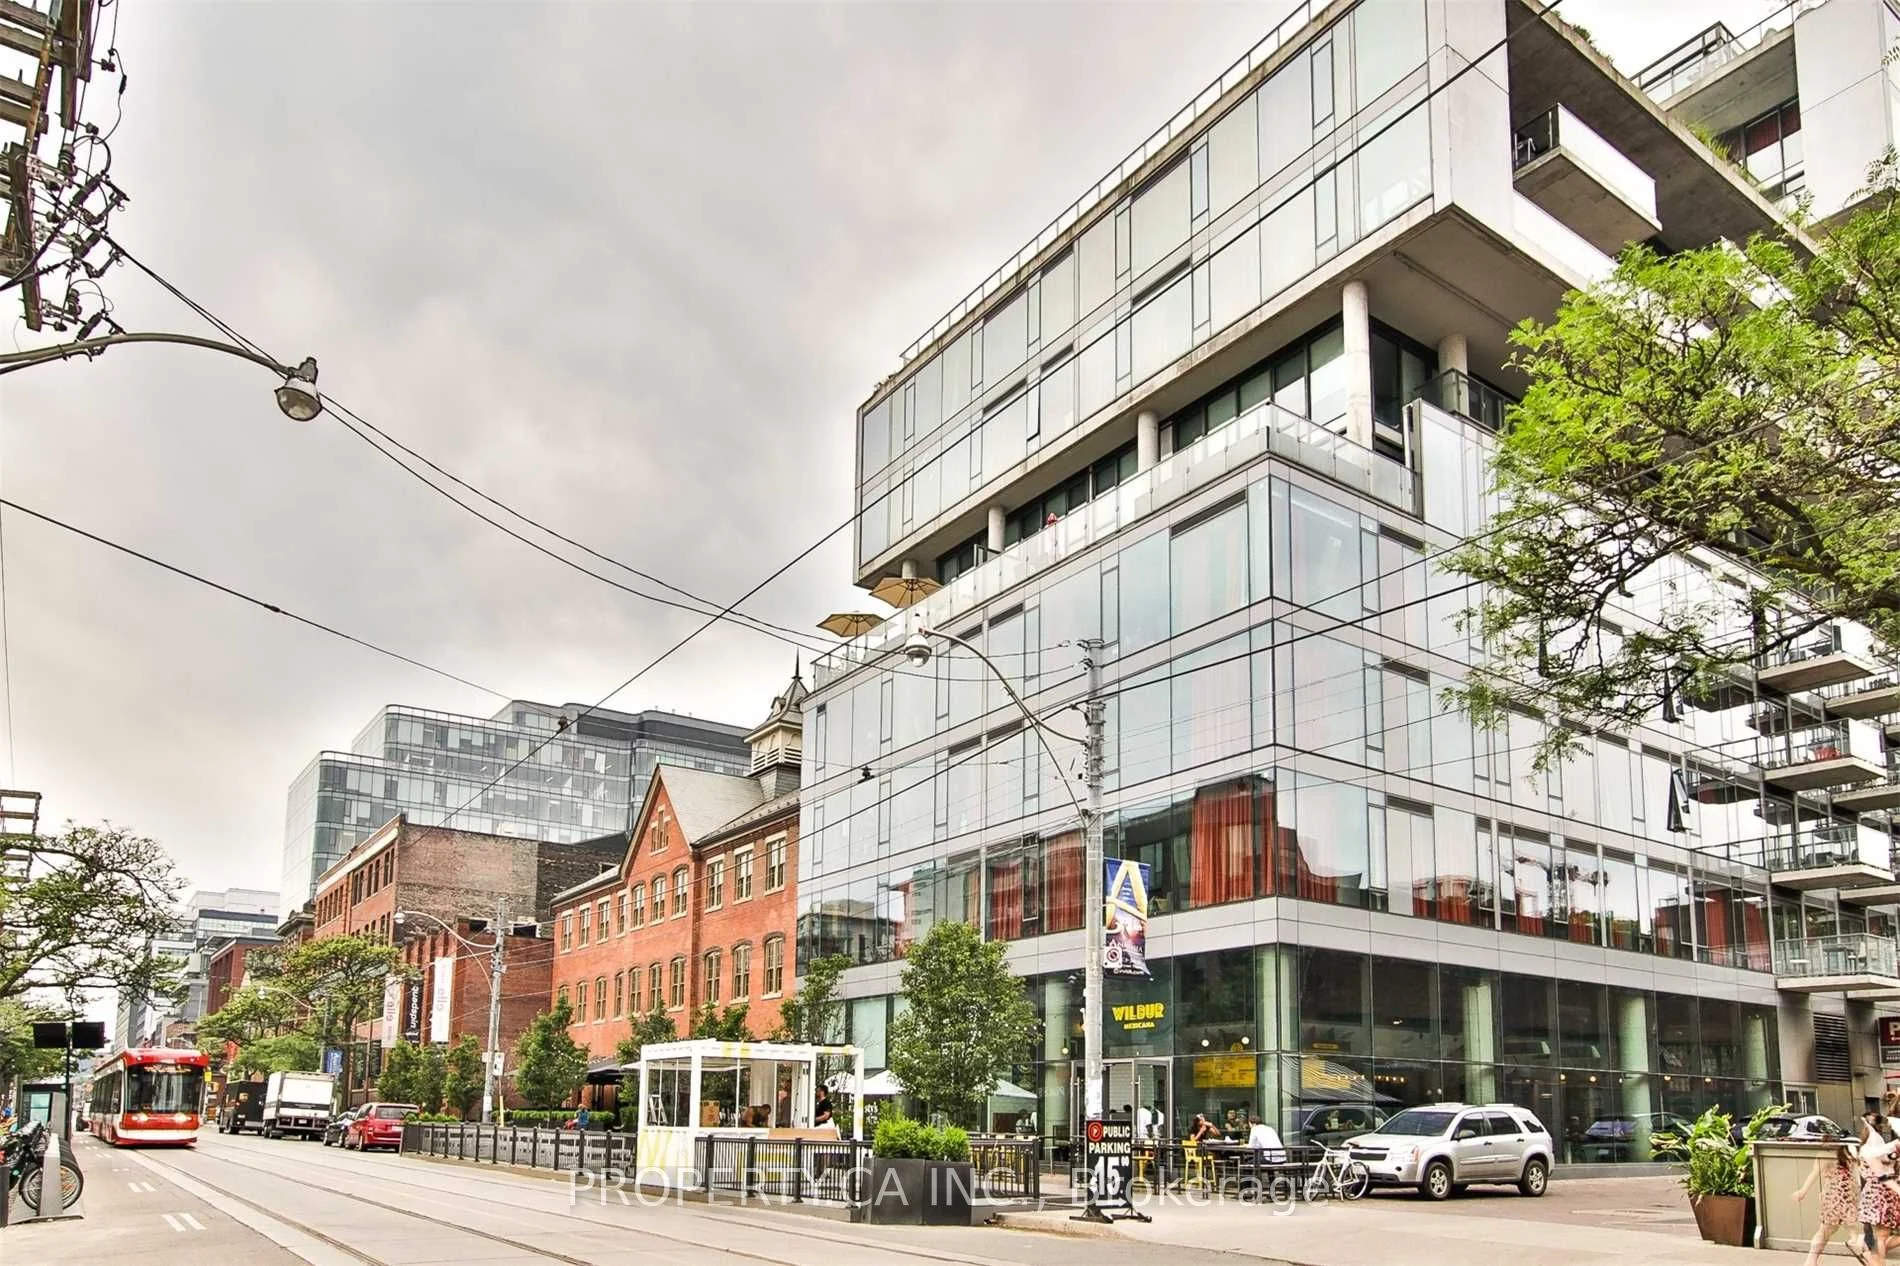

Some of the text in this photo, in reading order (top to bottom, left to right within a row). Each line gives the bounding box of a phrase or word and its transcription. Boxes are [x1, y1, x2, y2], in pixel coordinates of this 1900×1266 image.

[1111, 1002, 1165, 1021] WILBUR
[1102, 1125, 1131, 1138] PUBLIC
[1088, 1142, 1131, 1154] PARKING
